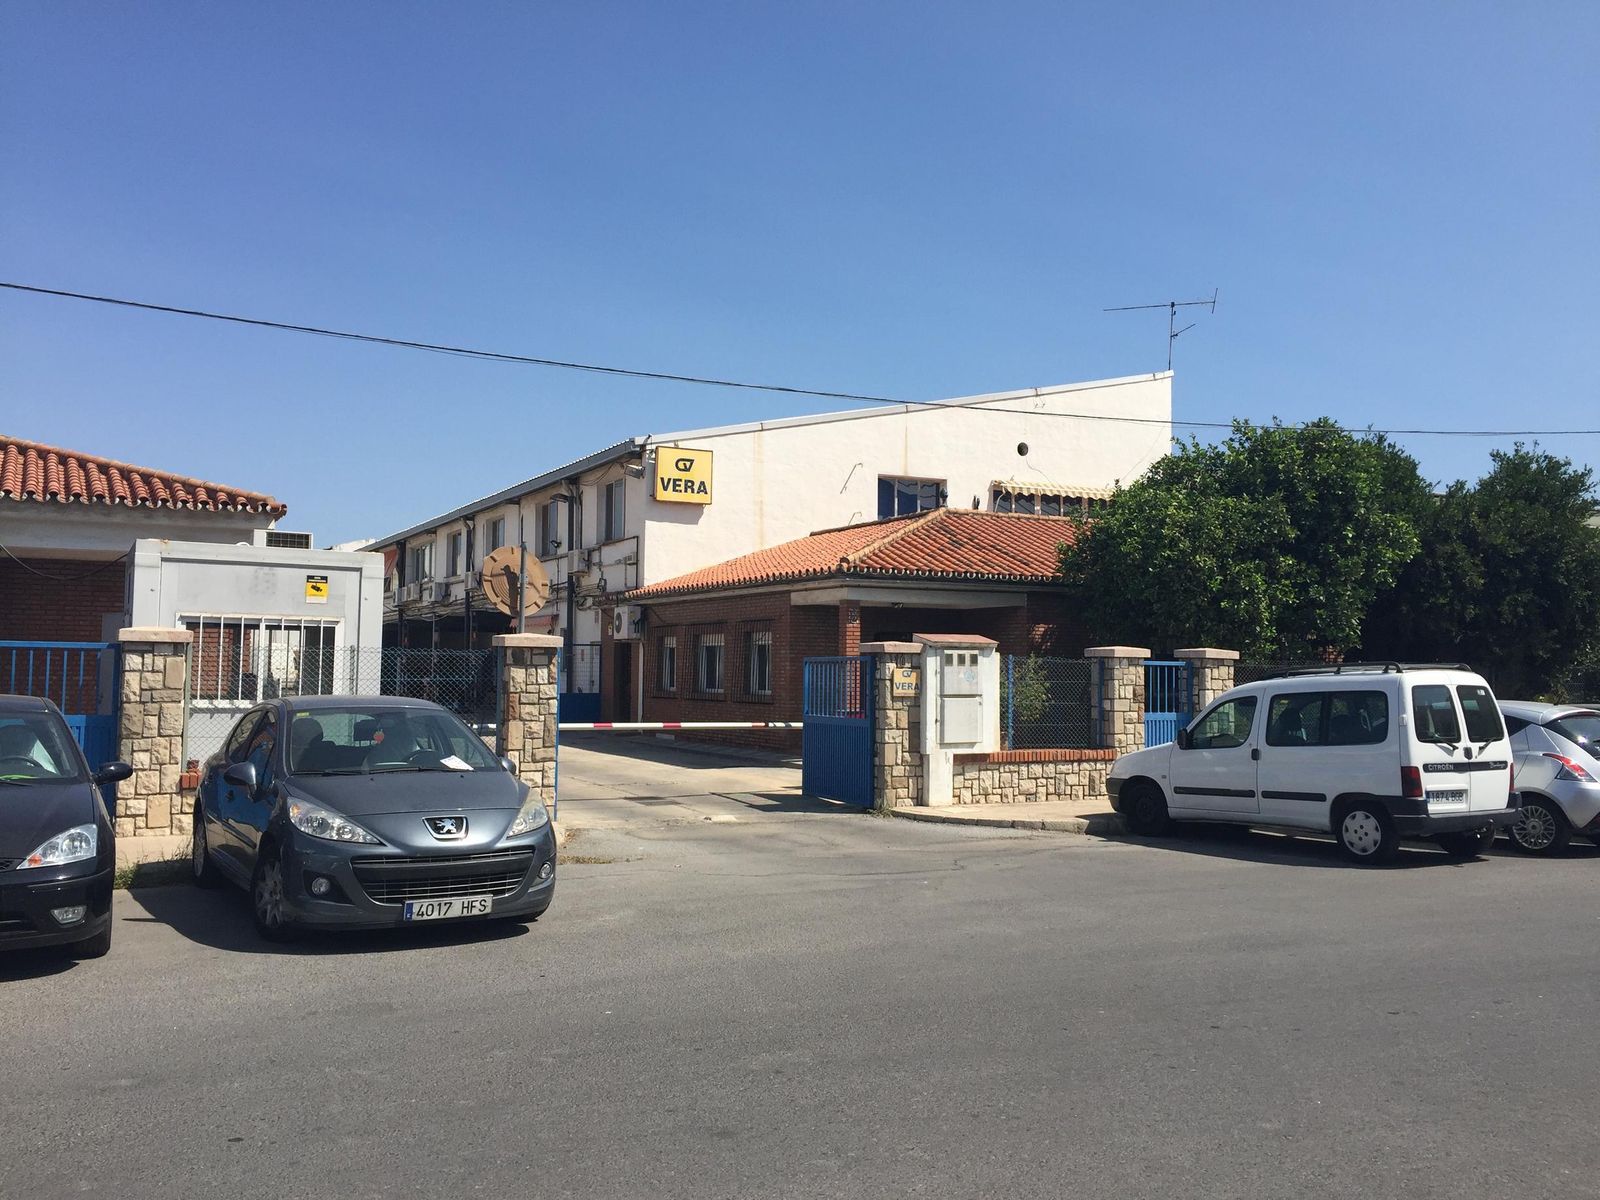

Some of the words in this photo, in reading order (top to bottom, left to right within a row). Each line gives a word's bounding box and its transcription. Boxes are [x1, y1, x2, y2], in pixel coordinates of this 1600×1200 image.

[660, 477, 708, 495] VERA
[895, 682, 919, 691] VERA
[416, 902, 453, 918] 4017
[461, 899, 487, 915] HFS
